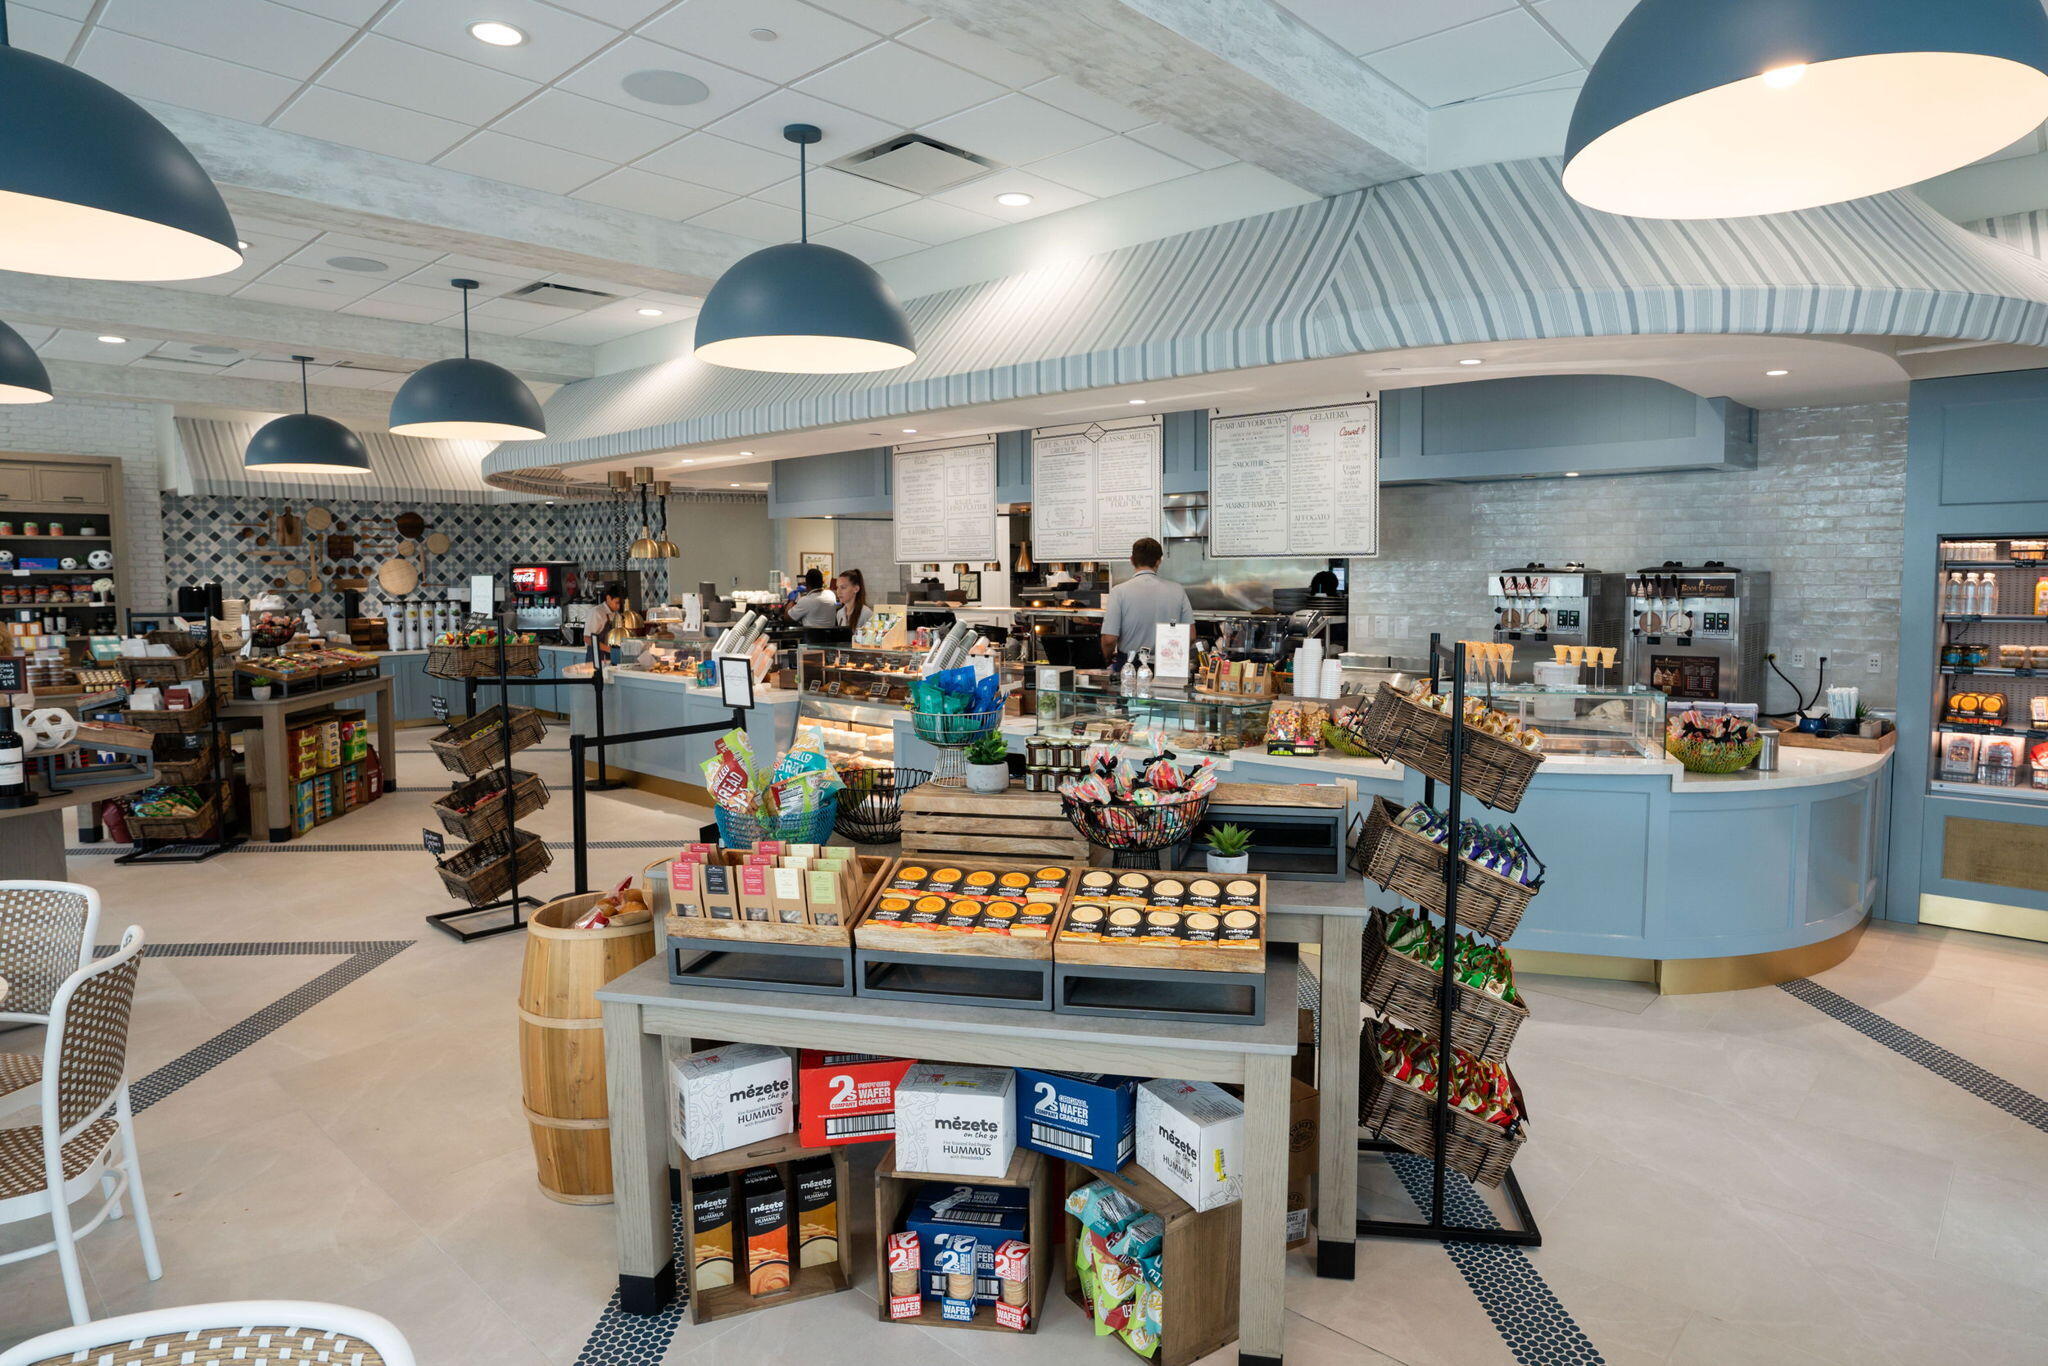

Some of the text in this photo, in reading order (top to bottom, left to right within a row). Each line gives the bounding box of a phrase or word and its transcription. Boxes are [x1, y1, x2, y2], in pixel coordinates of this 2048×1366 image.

[730, 1080, 789, 1102] mézete
[780, 1091, 789, 1099] go
[858, 1087, 891, 1098] WAFER
[858, 1096, 891, 1106] CRACKERS
[738, 1106, 783, 1124] HUMMUS
[1035, 1108, 1058, 1118] COMPANY
[1060, 1102, 1088, 1120] WAFER
[935, 1116, 998, 1132] mézete
[1060, 1112, 1088, 1126] CRACKERS
[1159, 1124, 1197, 1160] mézete
[943, 1146, 991, 1156] HUMMUS
[1163, 1154, 1192, 1182] HUMMUS
[800, 1178, 832, 1190] mézete
[694, 1198, 728, 1210] mézete
[750, 1201, 784, 1213] mézete
[977, 1252, 994, 1263] FER
[892, 1302, 920, 1312] WAFER
[944, 1305, 970, 1316] WAFER
[996, 1309, 1022, 1322] WAFER
